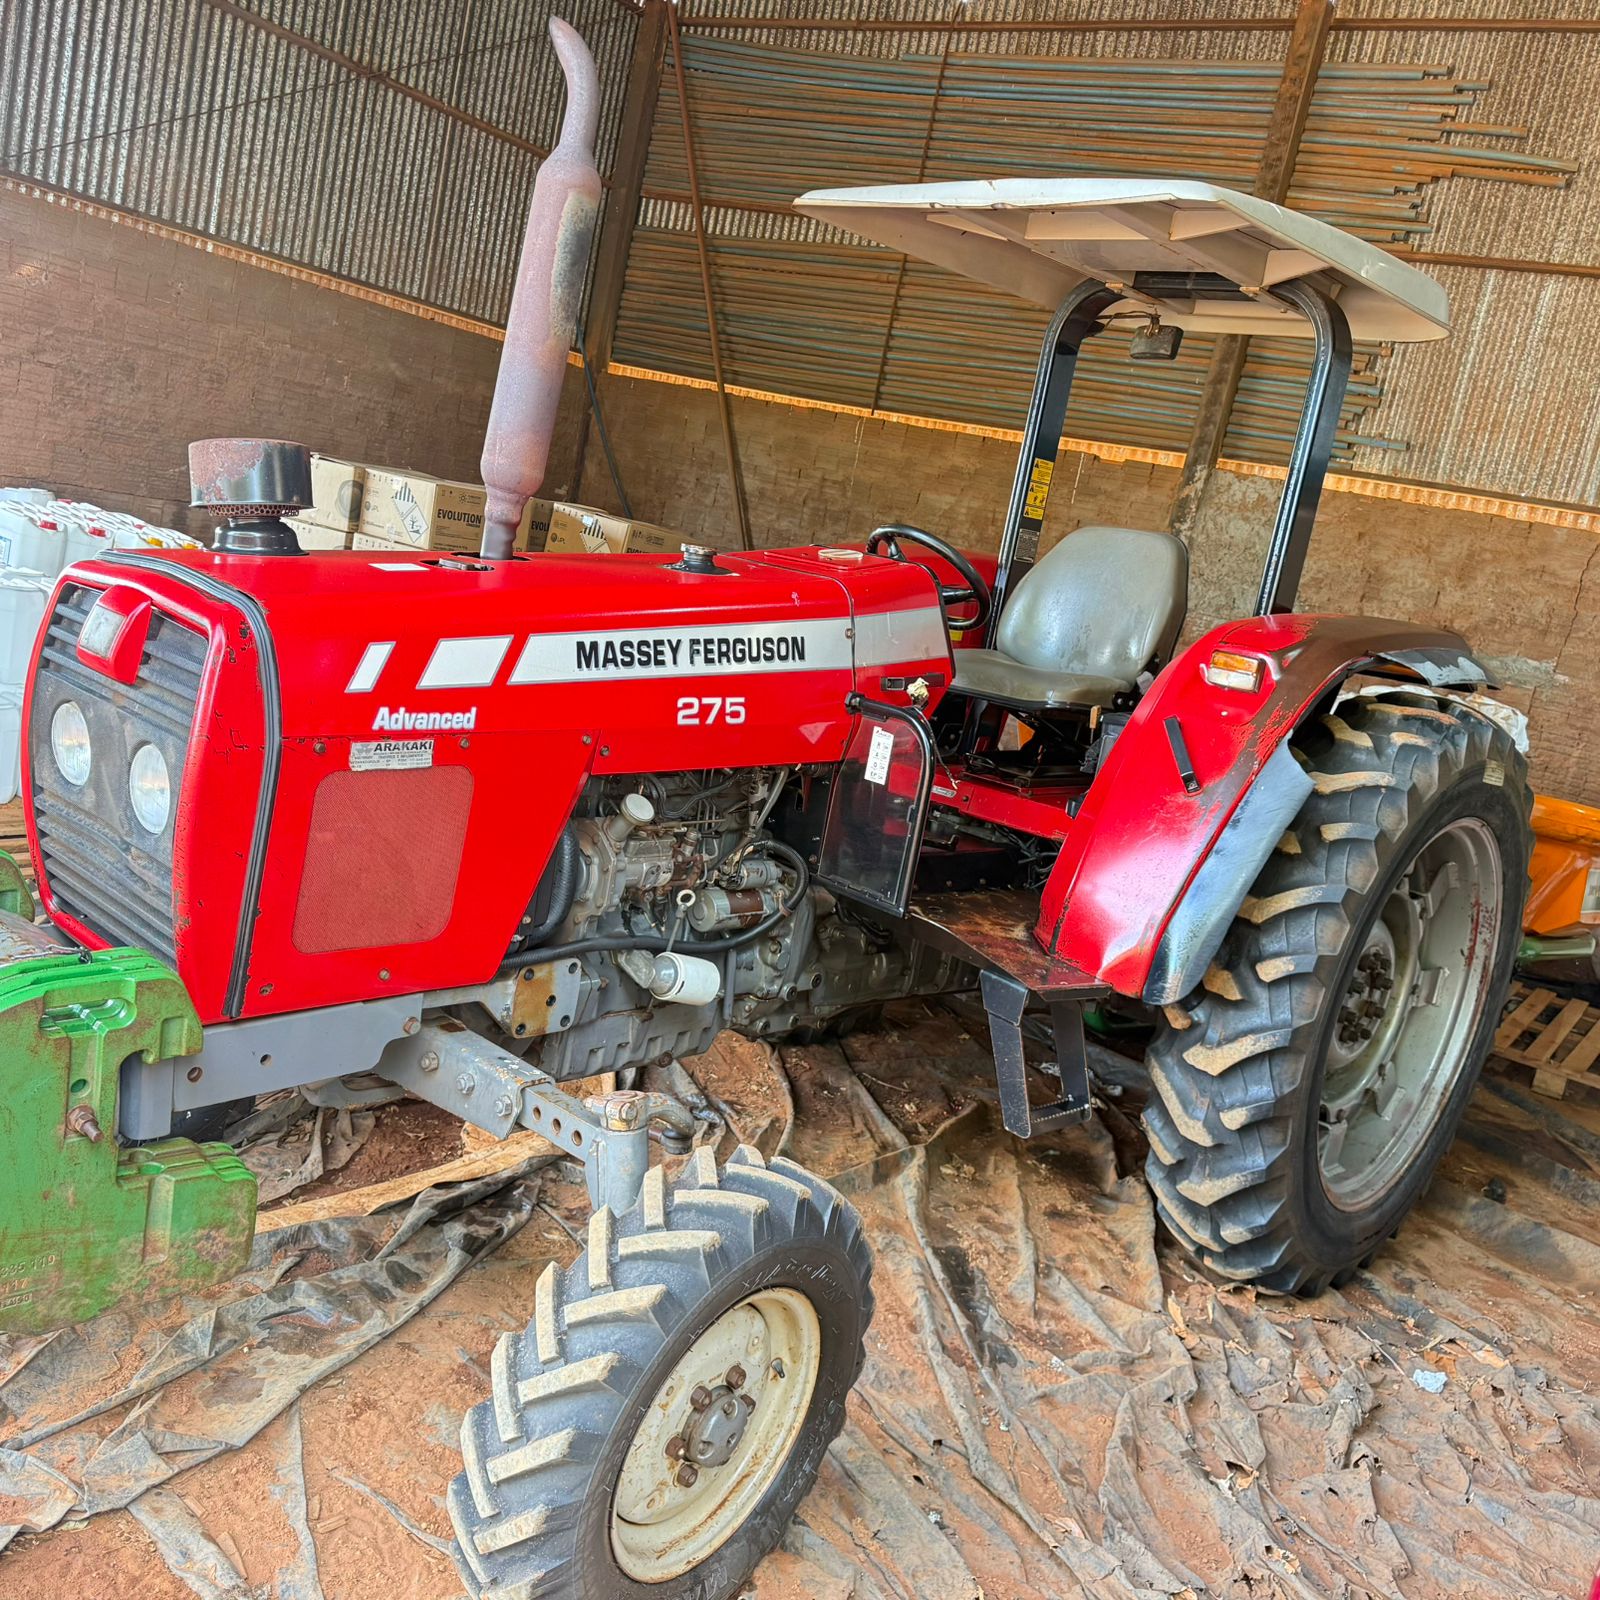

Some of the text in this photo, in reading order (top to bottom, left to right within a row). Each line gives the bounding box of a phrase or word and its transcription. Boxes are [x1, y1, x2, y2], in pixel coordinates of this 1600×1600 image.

[437, 508, 482, 524] EVOLUTION
[576, 636, 806, 670] MASSEY FERGUSON
[372, 706, 478, 731] Advanced
[676, 696, 746, 726] 275
[374, 741, 433, 752] ARAKAKI
